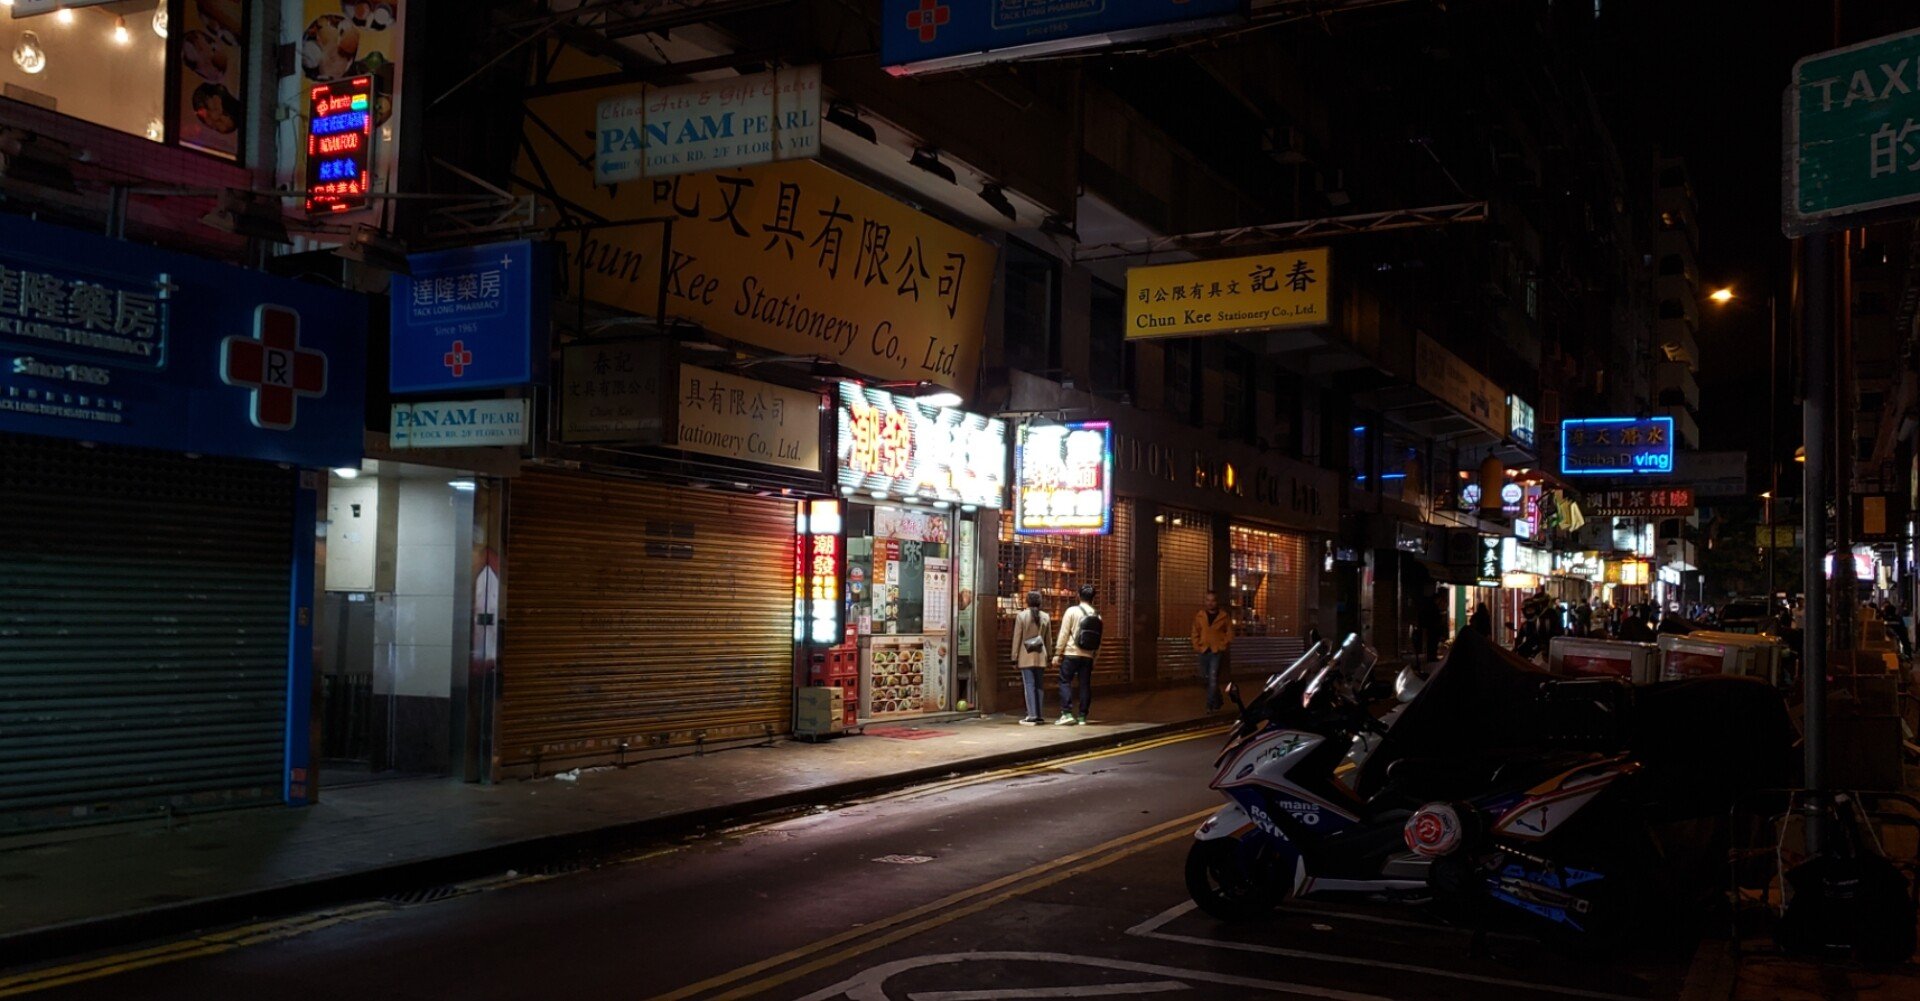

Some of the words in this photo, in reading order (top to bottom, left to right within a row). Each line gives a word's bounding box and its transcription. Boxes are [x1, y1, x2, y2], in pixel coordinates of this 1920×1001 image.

[601, 121, 672, 155] PAN
[675, 111, 736, 145] AM
[742, 109, 815, 136] PEARL
[412, 269, 501, 306] 達隆藥房
[413, 305, 432, 318] TACK
[433, 303, 455, 316] LONG
[456, 300, 500, 313] PHARMACY
[665, 250, 719, 306] Kee
[733, 275, 860, 356] Stationery
[921, 336, 958, 378] Ltd.
[1136, 313, 1176, 329] Chun
[1184, 309, 1212, 325] Kee
[1217, 310, 1270, 322] Stationery
[434, 325, 456, 337] Since
[396, 409, 440, 428] PAN
[442, 408, 477, 426] AM
[481, 411, 521, 425] PEARL
[681, 378, 785, 427] 具有限公司
[679, 424, 744, 456] tationery
[778, 438, 801, 461] Ltd.
